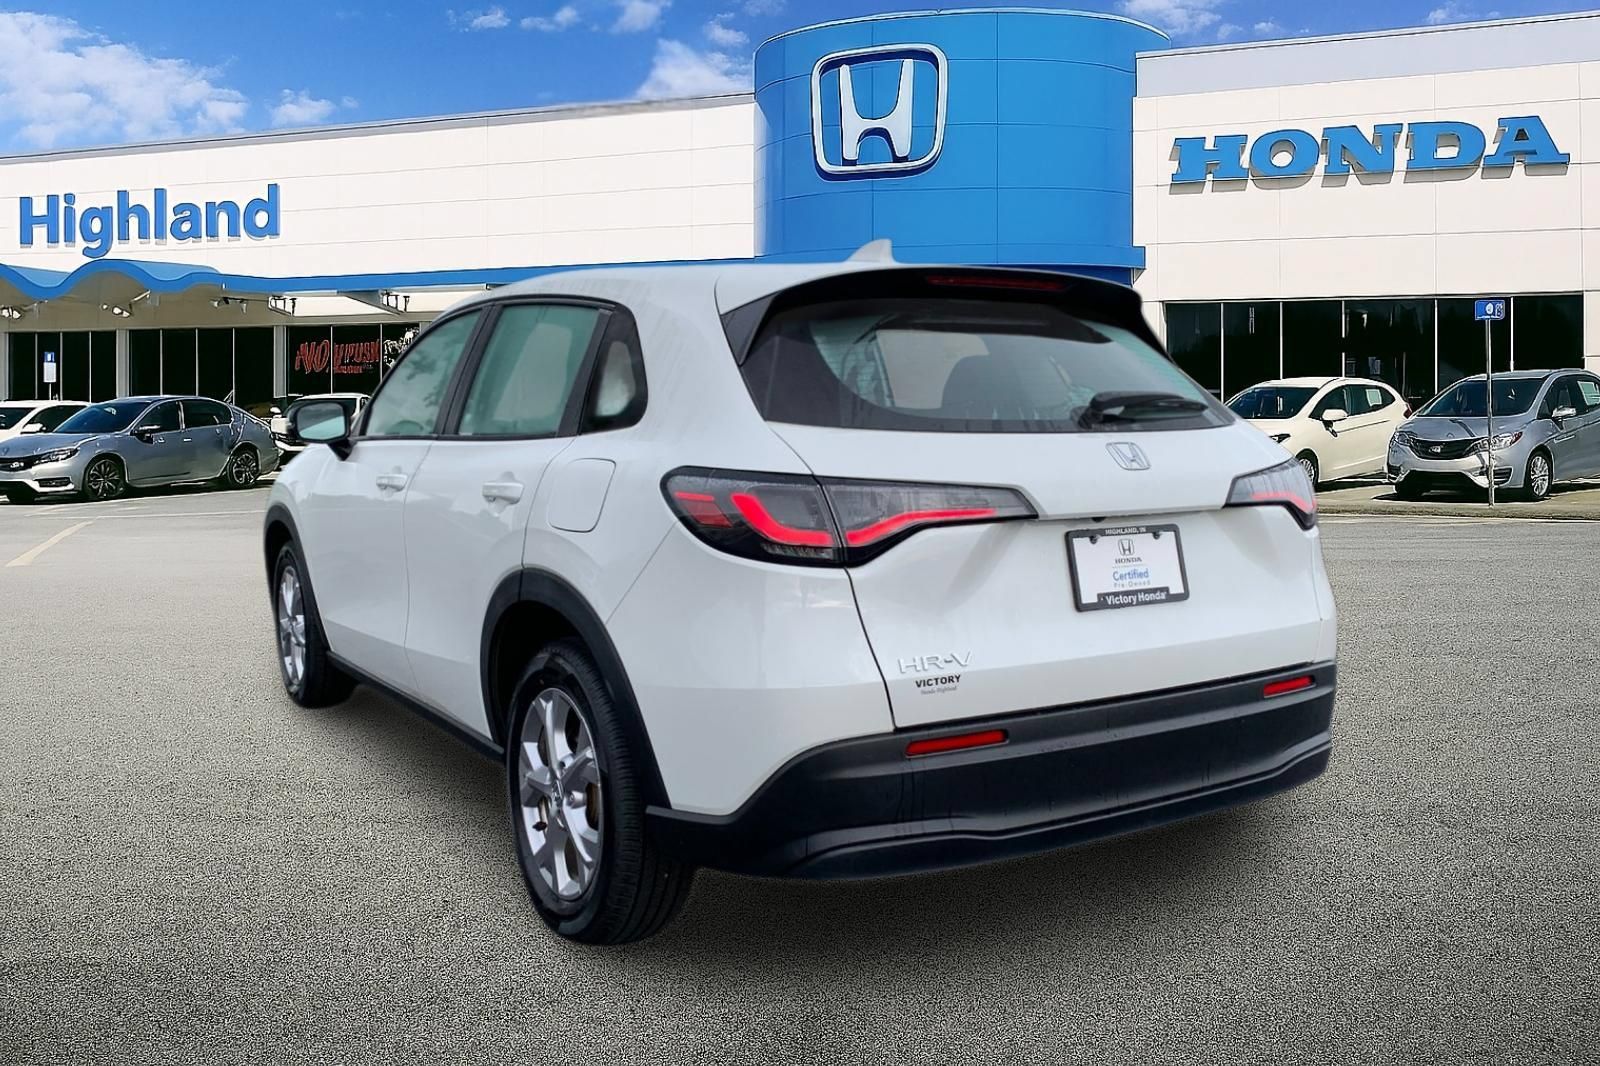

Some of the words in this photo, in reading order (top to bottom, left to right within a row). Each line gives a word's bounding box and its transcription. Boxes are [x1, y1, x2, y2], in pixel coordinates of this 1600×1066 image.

[1171, 115, 1570, 183] HONDA
[19, 183, 279, 258] Highland
[1113, 568, 1149, 581] Certified
[1105, 595, 1137, 605] Victory
[1138, 591, 1166, 601] Honda
[897, 651, 971, 674] HR-V
[915, 674, 961, 688] VICTORY
